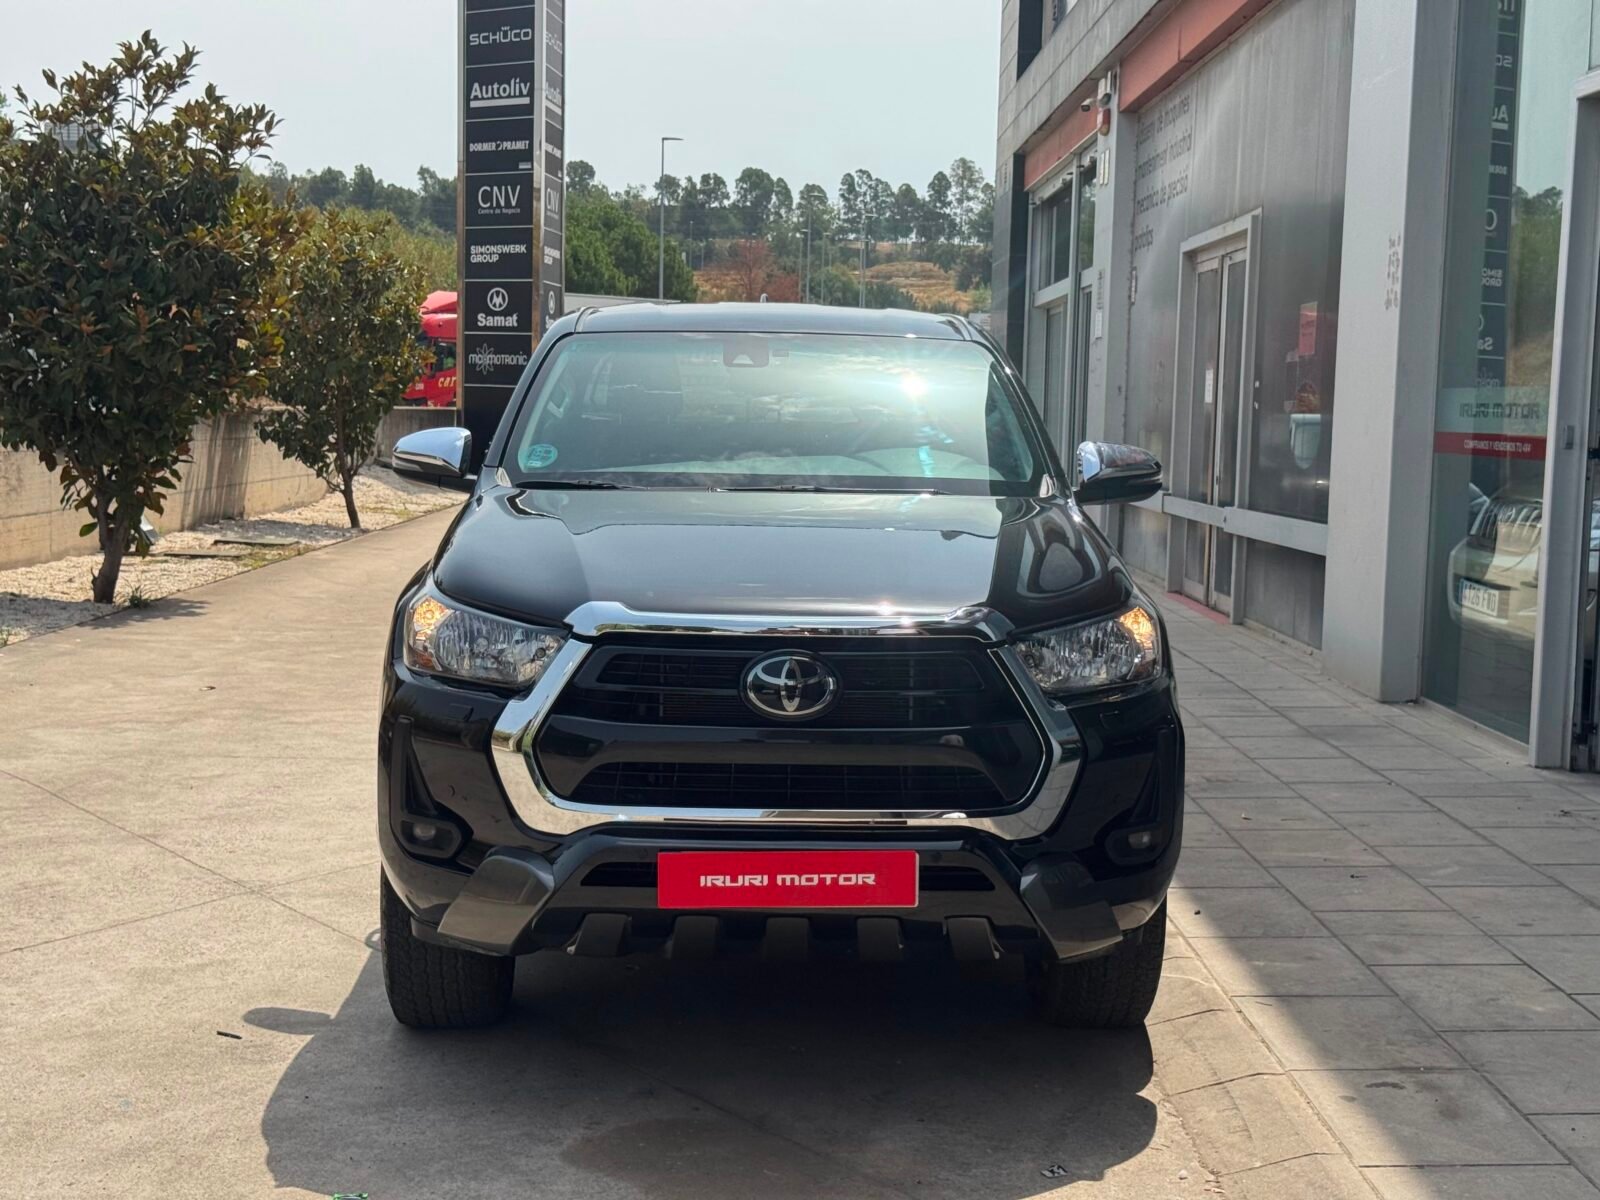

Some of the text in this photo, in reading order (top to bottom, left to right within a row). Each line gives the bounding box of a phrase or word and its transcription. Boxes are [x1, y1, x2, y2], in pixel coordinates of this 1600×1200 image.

[470, 77, 531, 99] Autoliv
[469, 141, 497, 153] DORMER
[502, 139, 530, 151] PRAMET
[478, 185, 521, 208] CNV
[470, 244, 527, 255] SIMONSWERK
[470, 254, 499, 263] GROUP
[477, 312, 518, 327] Samat
[1459, 403, 1540, 419] IRURI MOTOR
[700, 873, 876, 887] IRURI MOTOR
